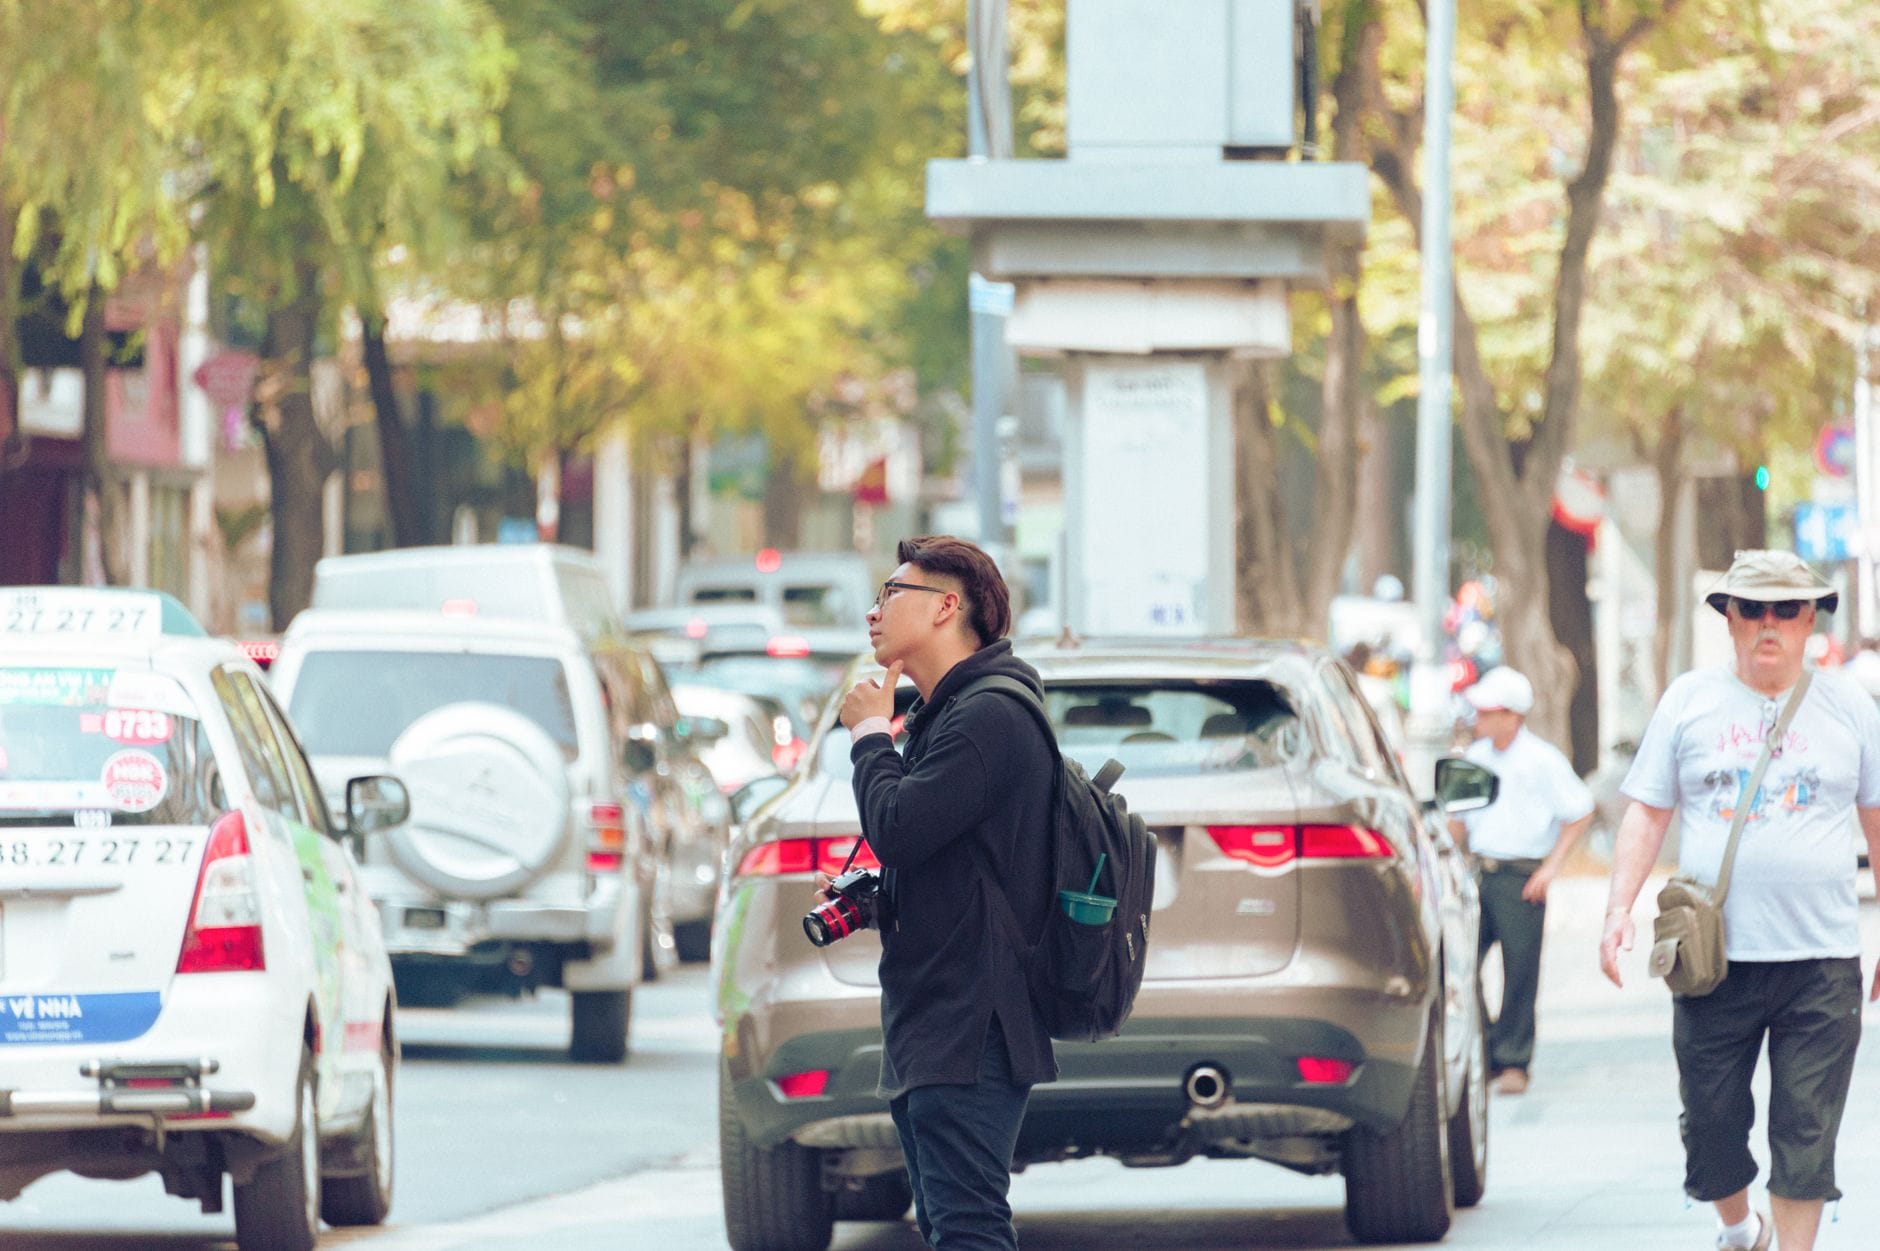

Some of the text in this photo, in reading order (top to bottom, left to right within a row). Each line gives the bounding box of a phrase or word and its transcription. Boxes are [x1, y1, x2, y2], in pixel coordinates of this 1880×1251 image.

[6, 606, 147, 632] 27 27 27
[0, 839, 194, 865] 8.27 27 27
